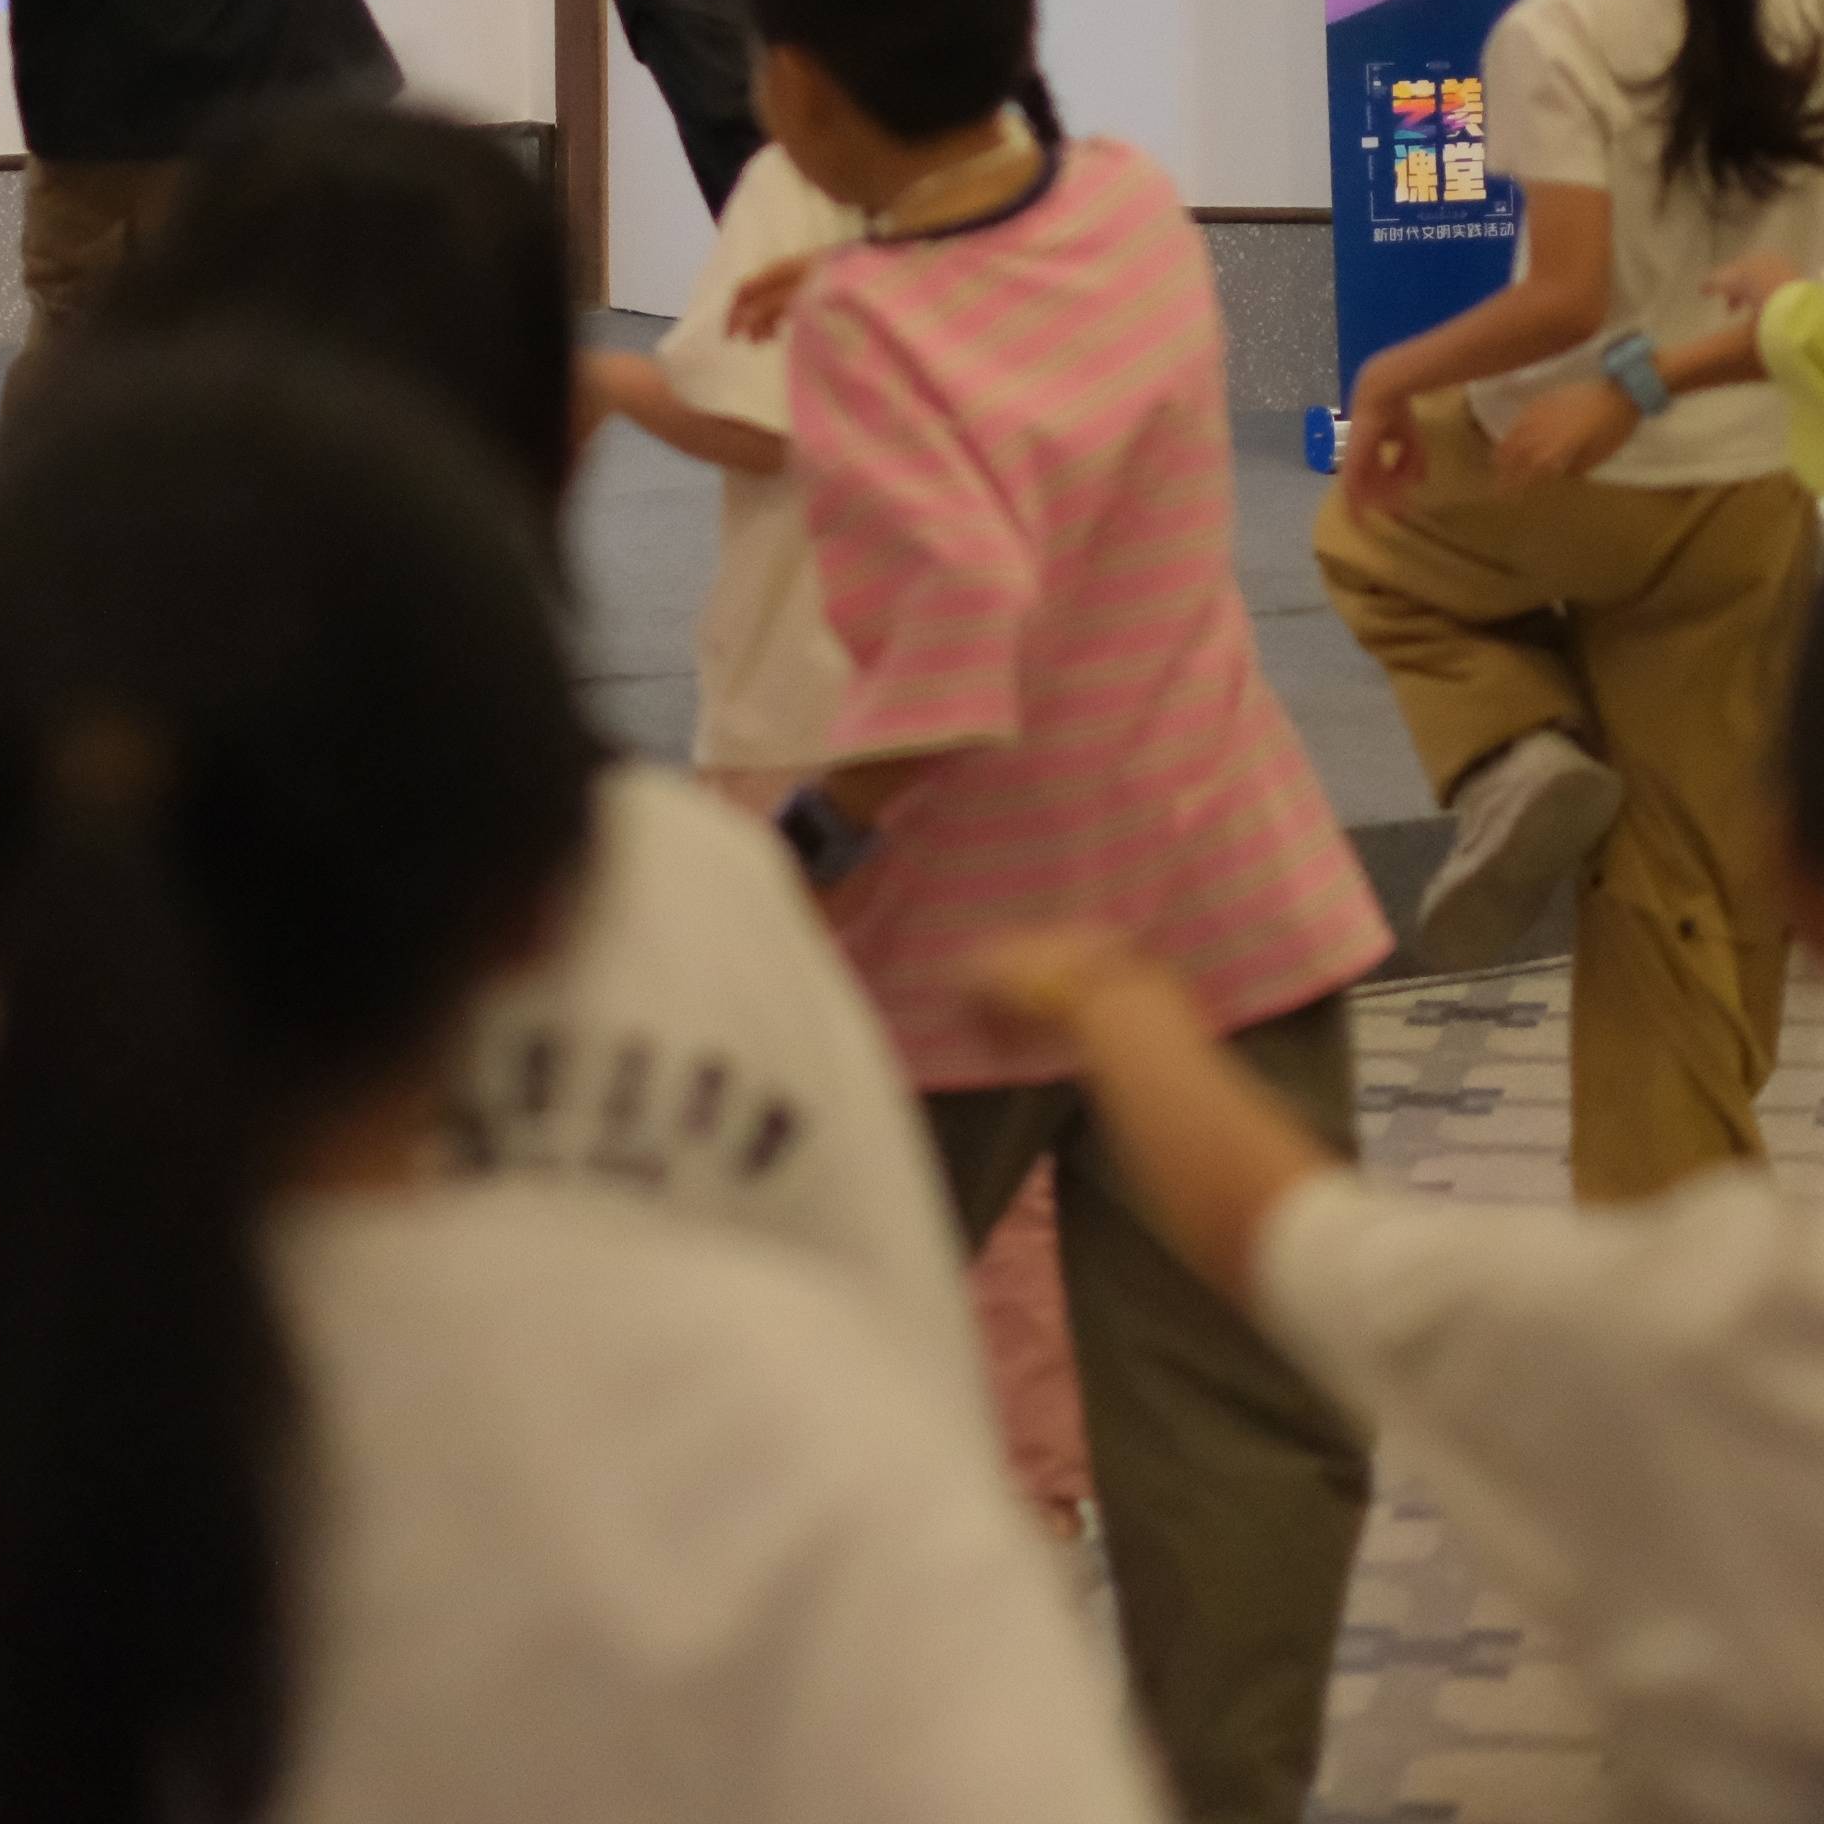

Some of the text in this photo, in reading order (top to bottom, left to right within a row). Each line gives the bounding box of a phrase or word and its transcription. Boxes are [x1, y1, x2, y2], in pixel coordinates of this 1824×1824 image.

[1394, 142, 1487, 203] 课堂
[1373, 222, 1515, 243] 新时代文明实践活动
